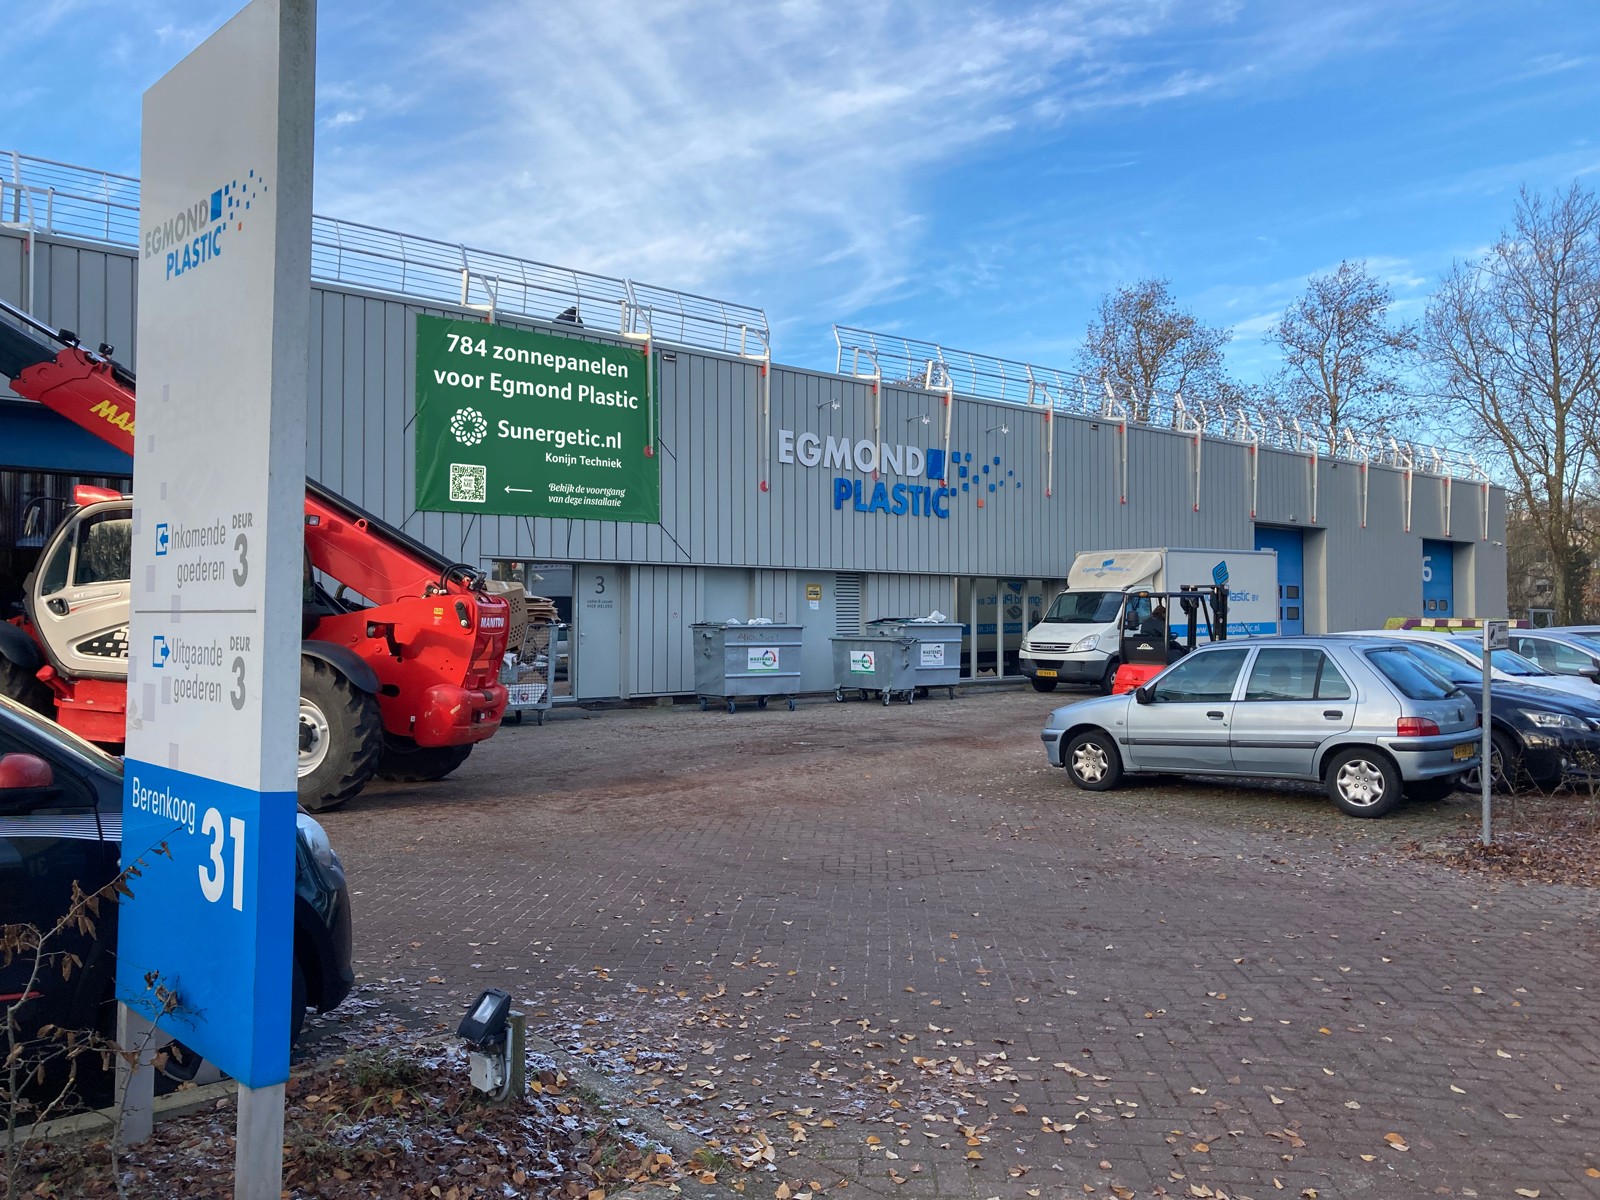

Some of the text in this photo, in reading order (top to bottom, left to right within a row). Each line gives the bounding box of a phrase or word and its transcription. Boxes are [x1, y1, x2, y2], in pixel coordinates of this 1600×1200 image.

[145, 199, 209, 259] EGMOND
[166, 225, 222, 281] PLASTIC
[447, 333, 629, 378] 784 zonnepanelen
[433, 369, 639, 409] voor Egmond Plastic
[497, 420, 622, 450] Sunergetic.nl
[545, 452, 622, 469] Konijn Techniek
[778, 429, 925, 478] EGMOND
[548, 483, 627, 498] Bekijk de voortgang
[548, 495, 622, 507] van deze installatie
[834, 477, 950, 519] PLASTIC
[171, 518, 226, 550] Inkomende
[232, 512, 253, 530] DEUR
[177, 555, 225, 588] goederen
[232, 533, 249, 588] 3
[1422, 556, 1433, 582] 6
[595, 575, 605, 595] 3
[1228, 590, 1250, 602] lastic
[480, 616, 505, 629] MANITOU
[171, 638, 223, 671] Uitgaande
[229, 636, 250, 652] DEUR
[173, 675, 222, 704] goederen
[230, 656, 247, 711] 3
[132, 776, 246, 912] Berenkoog 31
